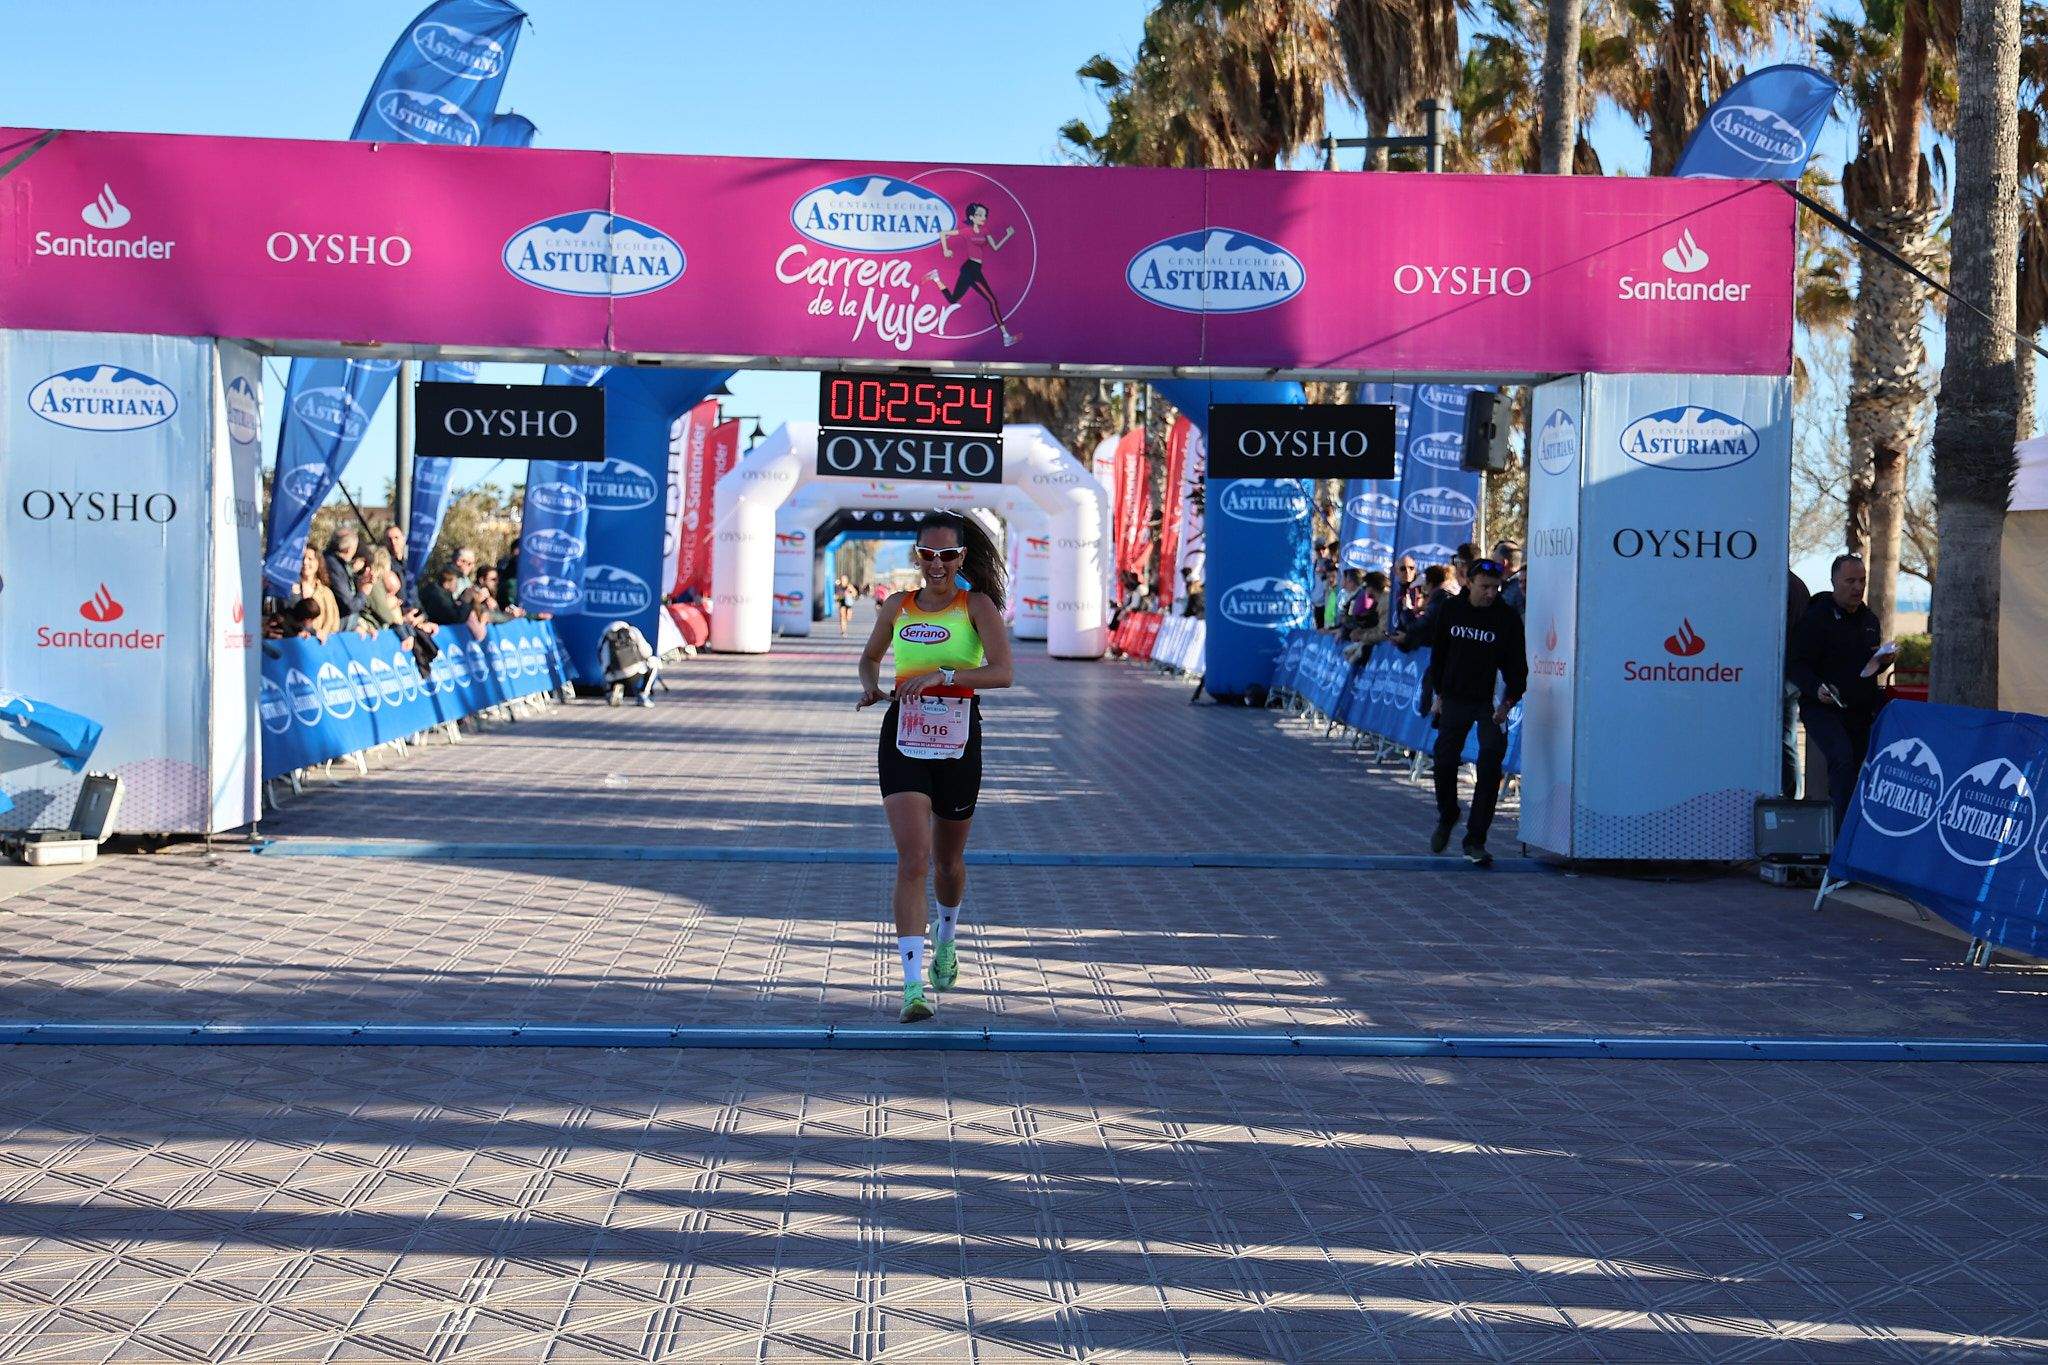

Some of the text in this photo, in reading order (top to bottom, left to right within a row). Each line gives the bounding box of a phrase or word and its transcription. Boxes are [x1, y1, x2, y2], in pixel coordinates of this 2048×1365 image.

[1716, 113, 1796, 159] ASTURIANA
[805, 202, 942, 233] ASTURIANA
[35, 231, 175, 260] Santander
[266, 231, 411, 266] OYSHO
[518, 240, 671, 277] ASTURIANA
[775, 243, 913, 289] Carrera
[1141, 259, 1291, 291] ASTURIANA
[1393, 264, 1531, 296] OYSHO
[1618, 275, 1751, 303] Santander
[808, 285, 961, 351] de la Mujer
[40, 388, 167, 416] ASTURIANA
[831, 379, 993, 425] 00:25:24
[443, 407, 578, 438] OYSHO
[826, 435, 995, 477] OYSHO
[1238, 429, 1368, 457] OYSHO
[1630, 429, 1748, 455] ASTURIANA
[22, 489, 177, 524] OYSHO
[587, 482, 652, 500] TURIANA
[851, 510, 927, 522] VOLV
[1534, 527, 1573, 557] OYSHO
[1613, 528, 1758, 560] OYSHO
[37, 627, 164, 650] Santander
[902, 625, 946, 640] Serrano
[1450, 625, 1495, 643] OYSHO
[1624, 661, 1743, 682] Santander
[922, 725, 948, 735] 016
[1868, 763, 1934, 819] ASTURIANA
[1940, 788, 2024, 847] ASTURIANA
